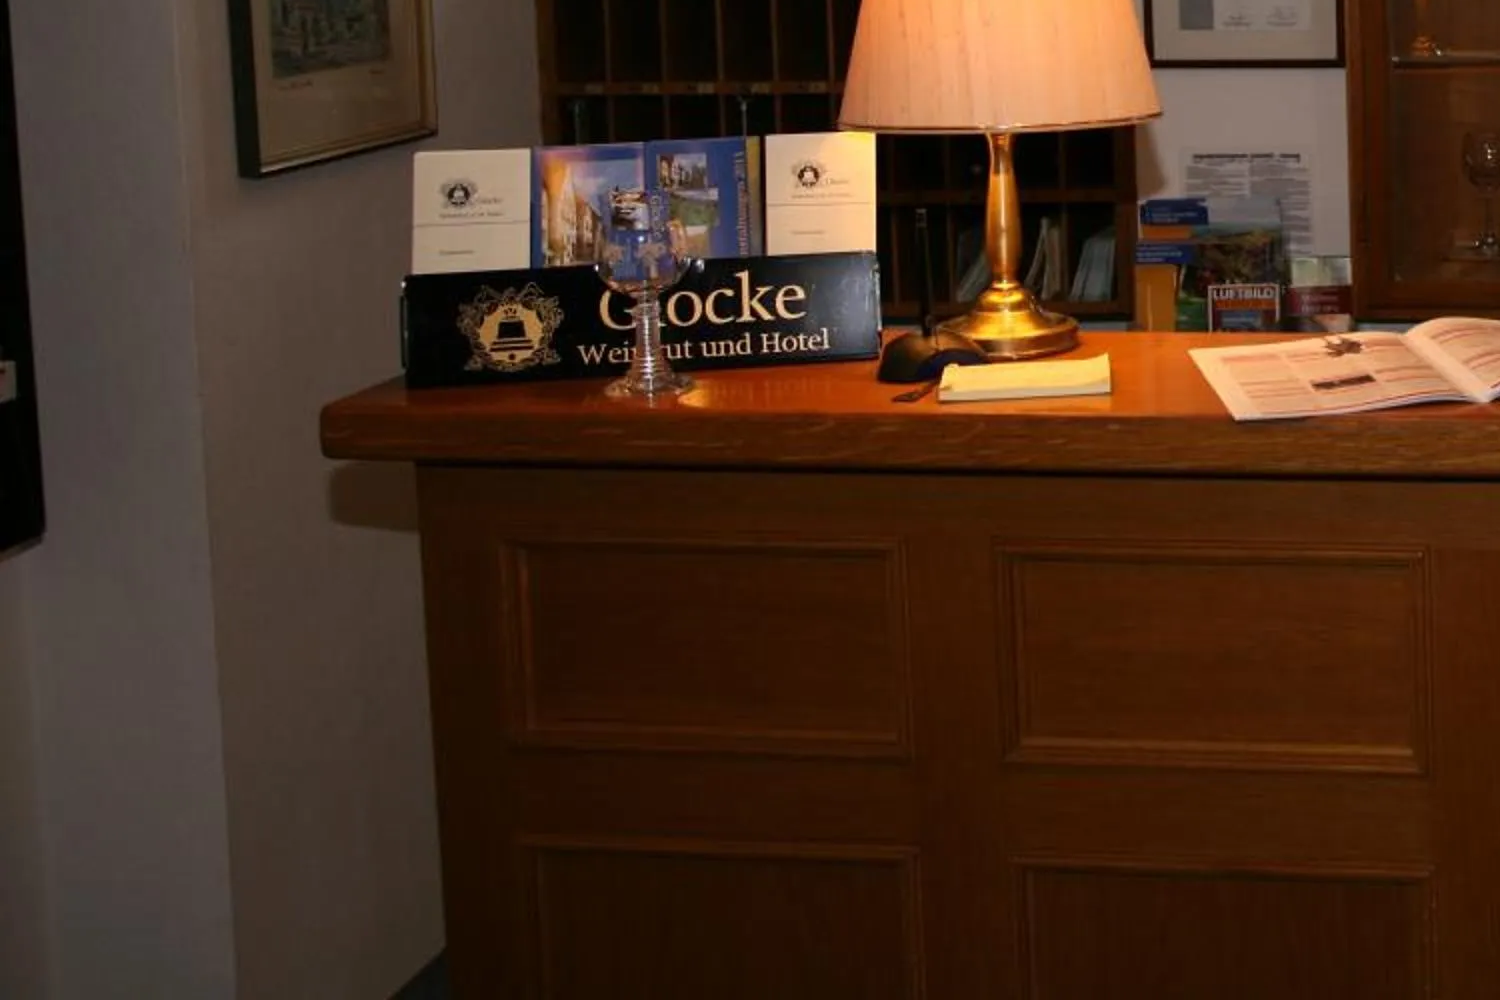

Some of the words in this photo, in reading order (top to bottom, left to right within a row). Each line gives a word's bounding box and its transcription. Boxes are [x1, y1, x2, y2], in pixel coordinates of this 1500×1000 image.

[599, 269, 807, 331] Gocke
[577, 339, 692, 367] Weiut
[700, 328, 751, 358] und
[760, 327, 830, 354] Hotel
